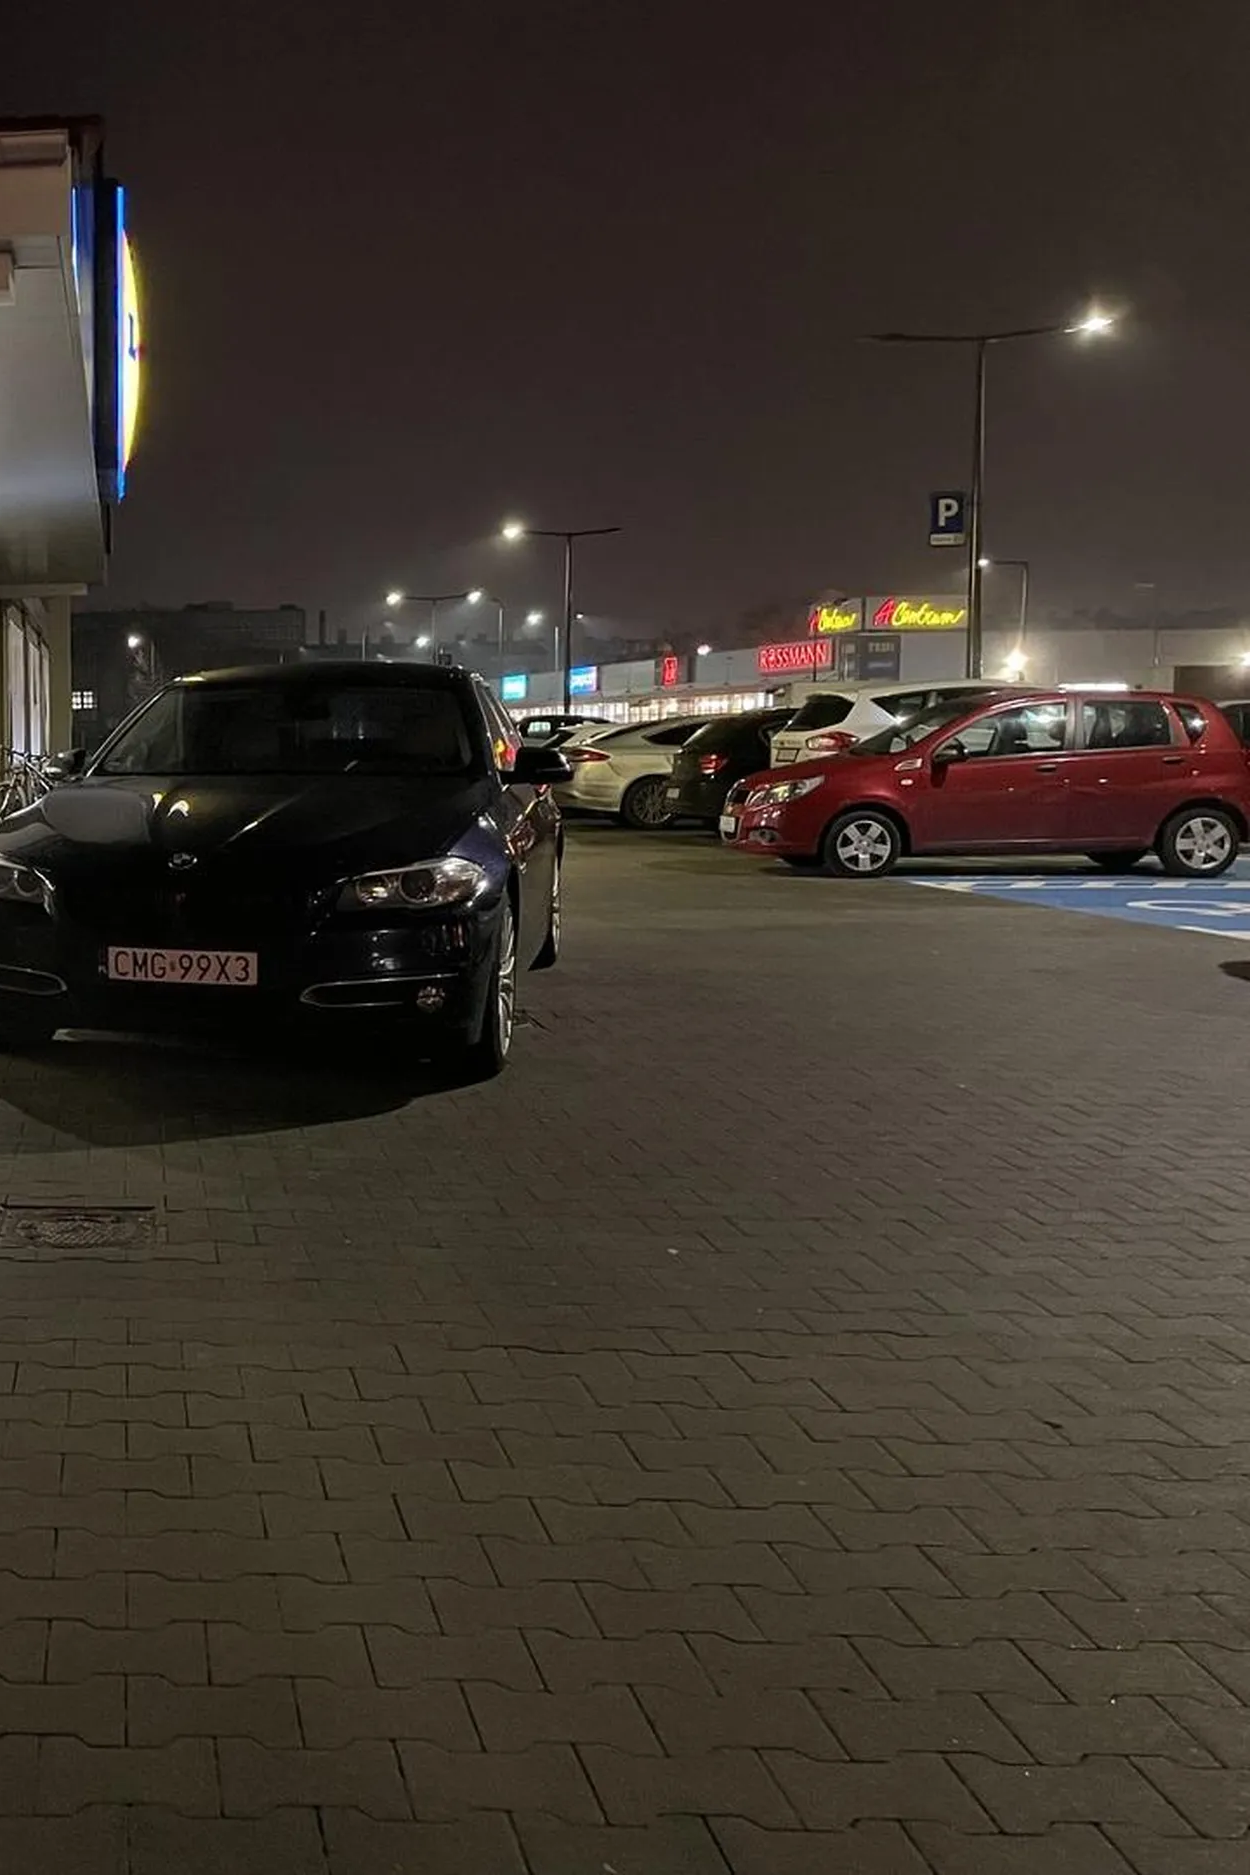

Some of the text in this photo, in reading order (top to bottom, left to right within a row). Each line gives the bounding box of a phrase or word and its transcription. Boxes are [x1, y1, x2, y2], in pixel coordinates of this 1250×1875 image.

[937, 498, 959, 527] P
[872, 596, 965, 626] A Centrum
[759, 642, 828, 669] ROSSMANN
[113, 950, 250, 982] CMG 99X3
